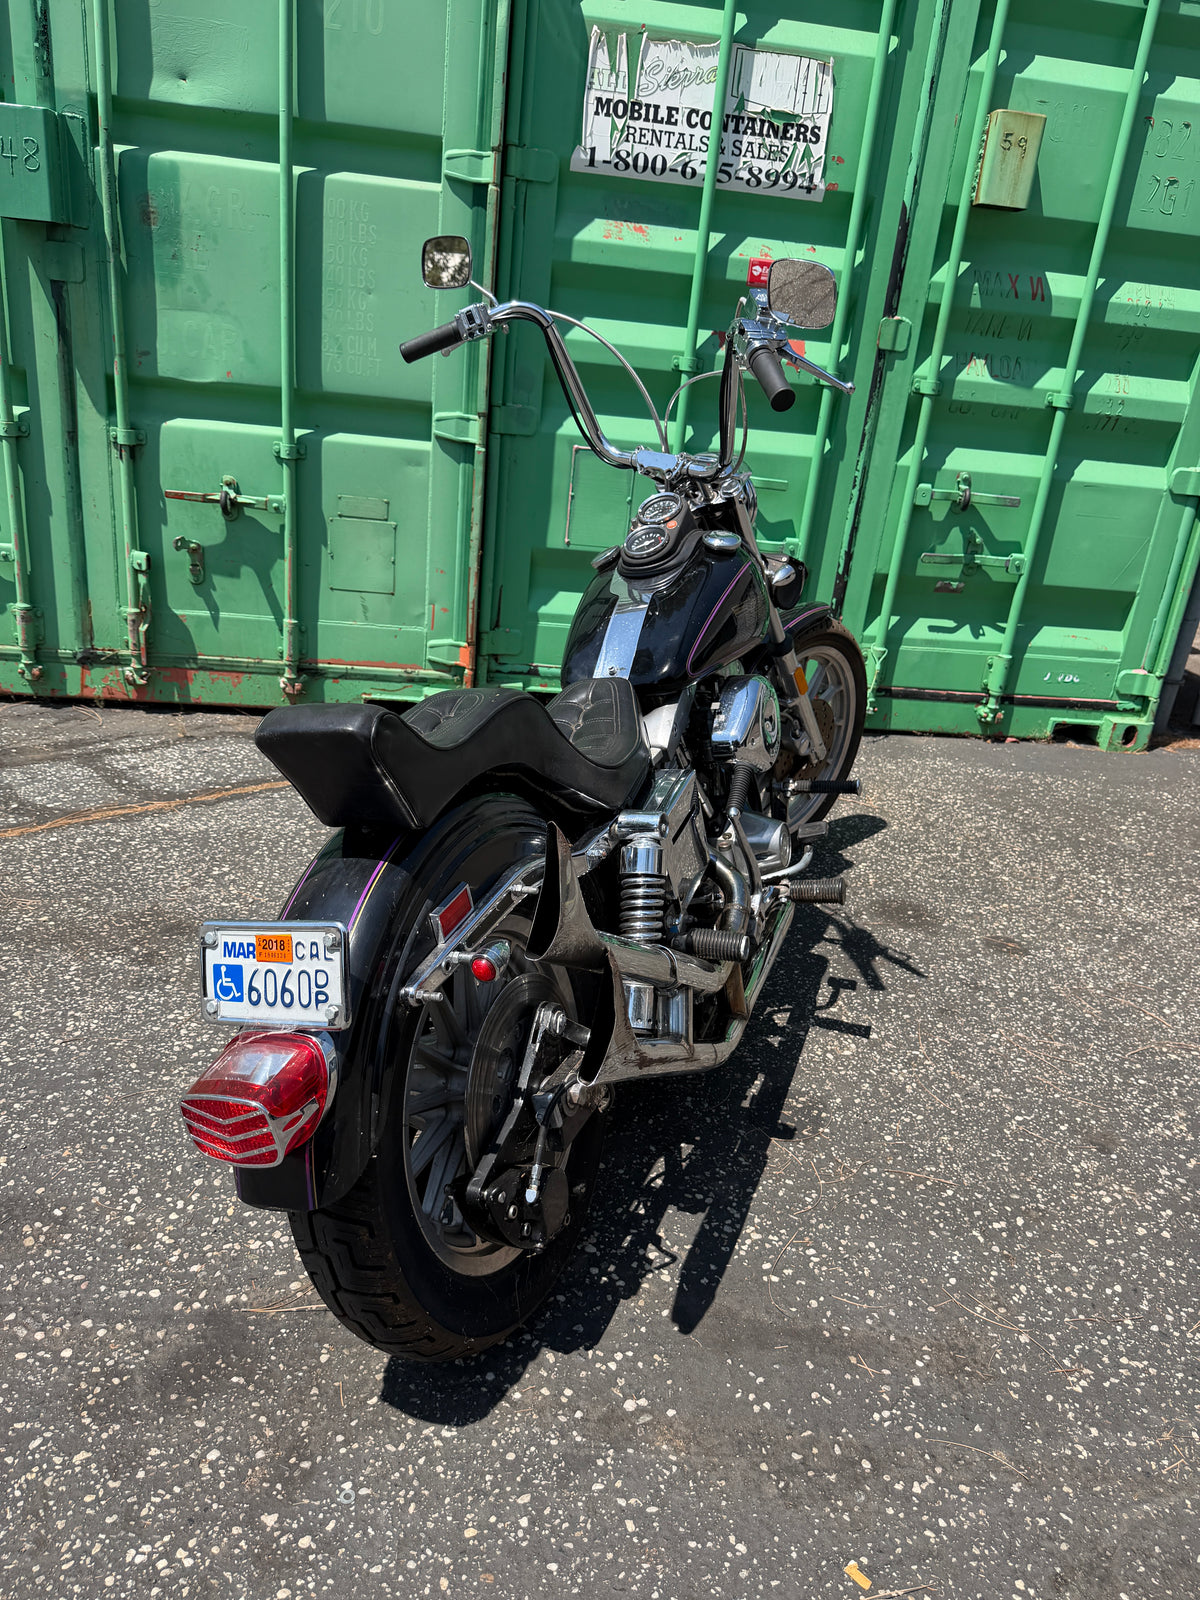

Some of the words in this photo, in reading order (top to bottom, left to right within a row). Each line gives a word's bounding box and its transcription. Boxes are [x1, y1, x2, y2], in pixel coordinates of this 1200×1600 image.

[638, 58, 718, 97] Sierra
[594, 96, 679, 125] MOBILE
[686, 107, 821, 144] CONTAINERS
[623, 125, 709, 152] RENTALS
[731, 140, 791, 163] SALES
[1000, 131, 1029, 159] 59
[584, 146, 818, 194] 1-800-65-8994
[223, 941, 256, 960] MAR
[262, 938, 285, 951] 2018
[248, 968, 312, 1009] 6060
